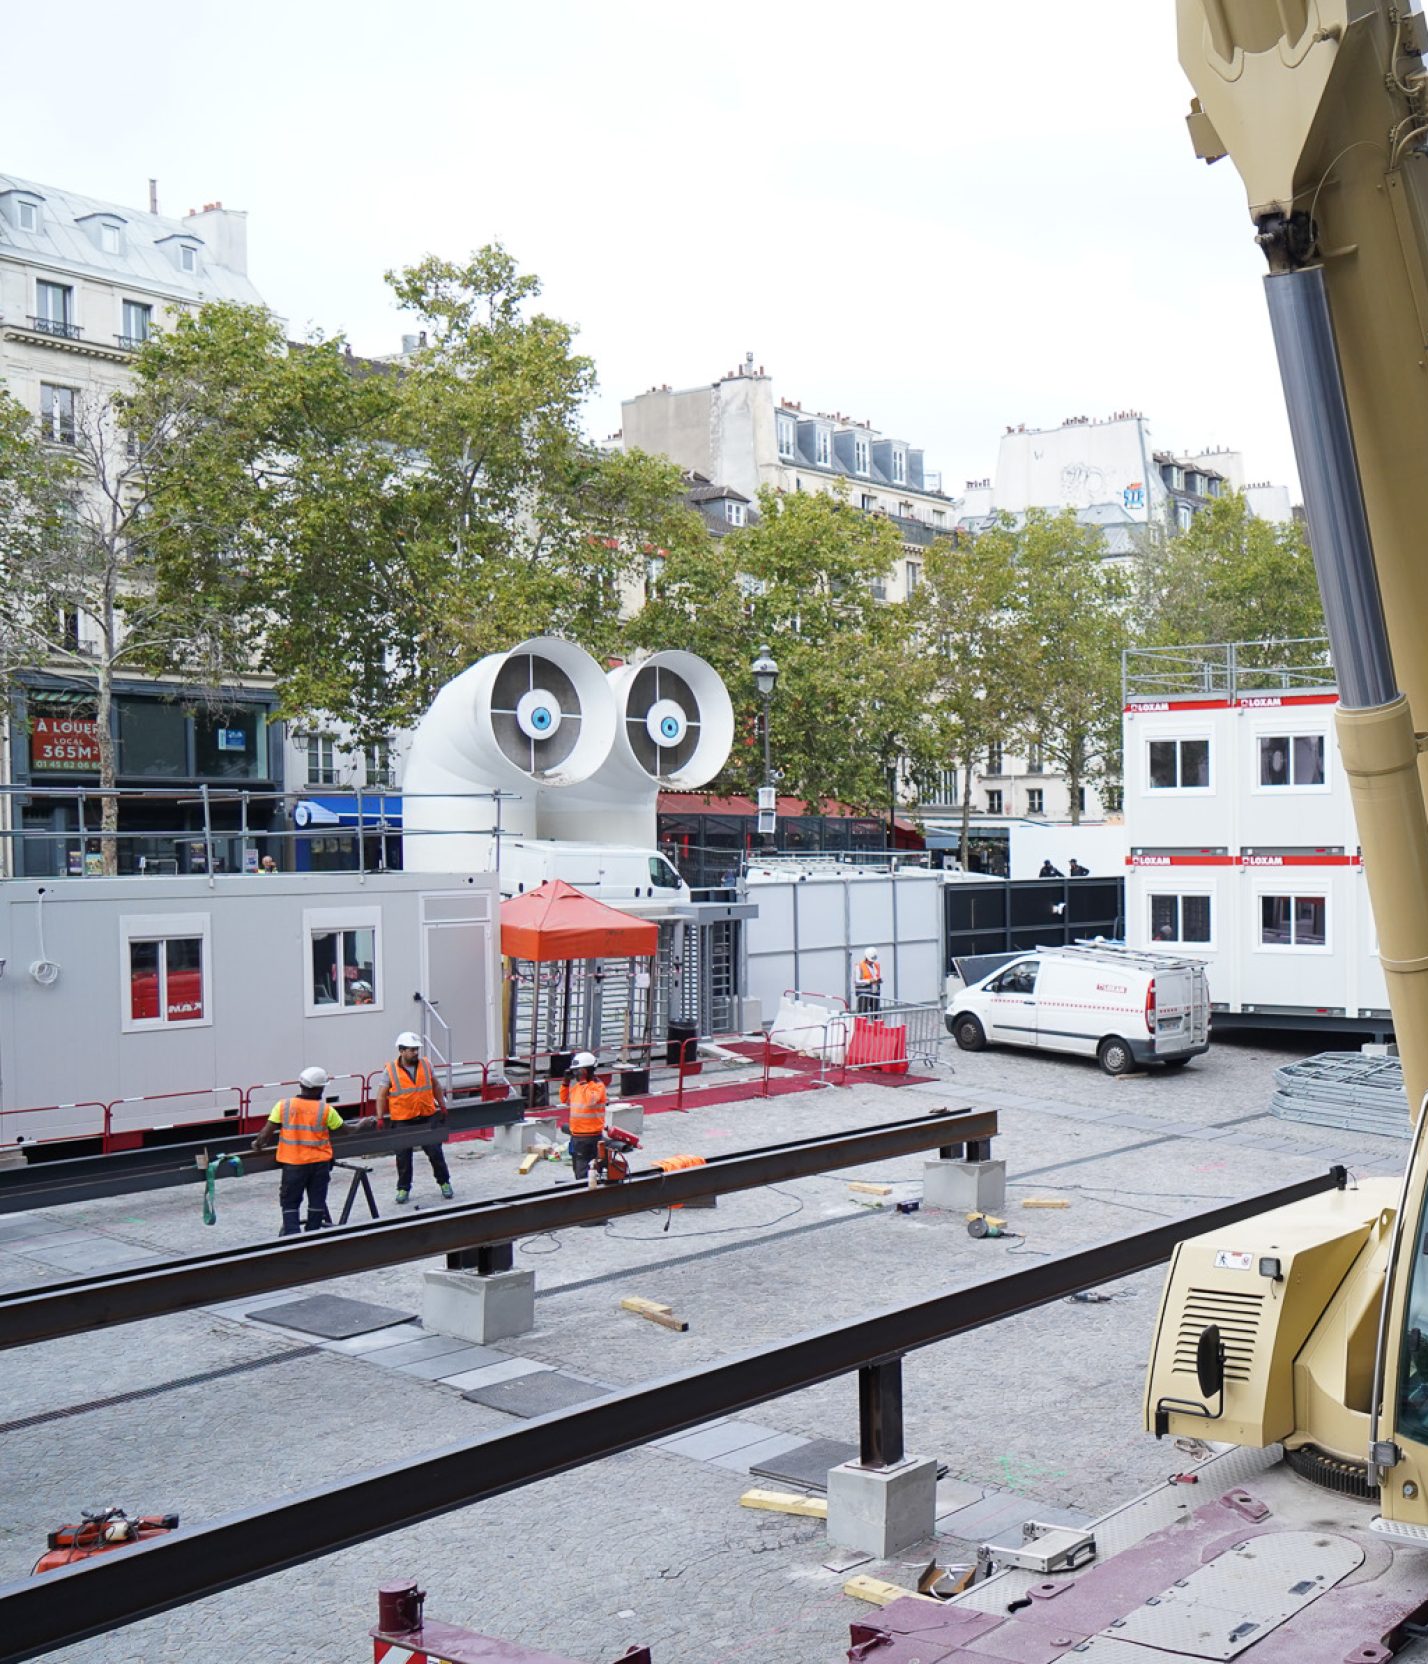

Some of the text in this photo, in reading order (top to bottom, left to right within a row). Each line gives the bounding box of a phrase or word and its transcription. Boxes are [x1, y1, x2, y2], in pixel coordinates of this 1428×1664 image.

[1249, 697, 1282, 707] LOXAM
[1138, 702, 1169, 712] LOXAM
[37, 718, 48, 732] À
[54, 737, 84, 746] LOCAL
[1140, 857, 1170, 865] LOXAM
[1250, 857, 1283, 865] LOXAM
